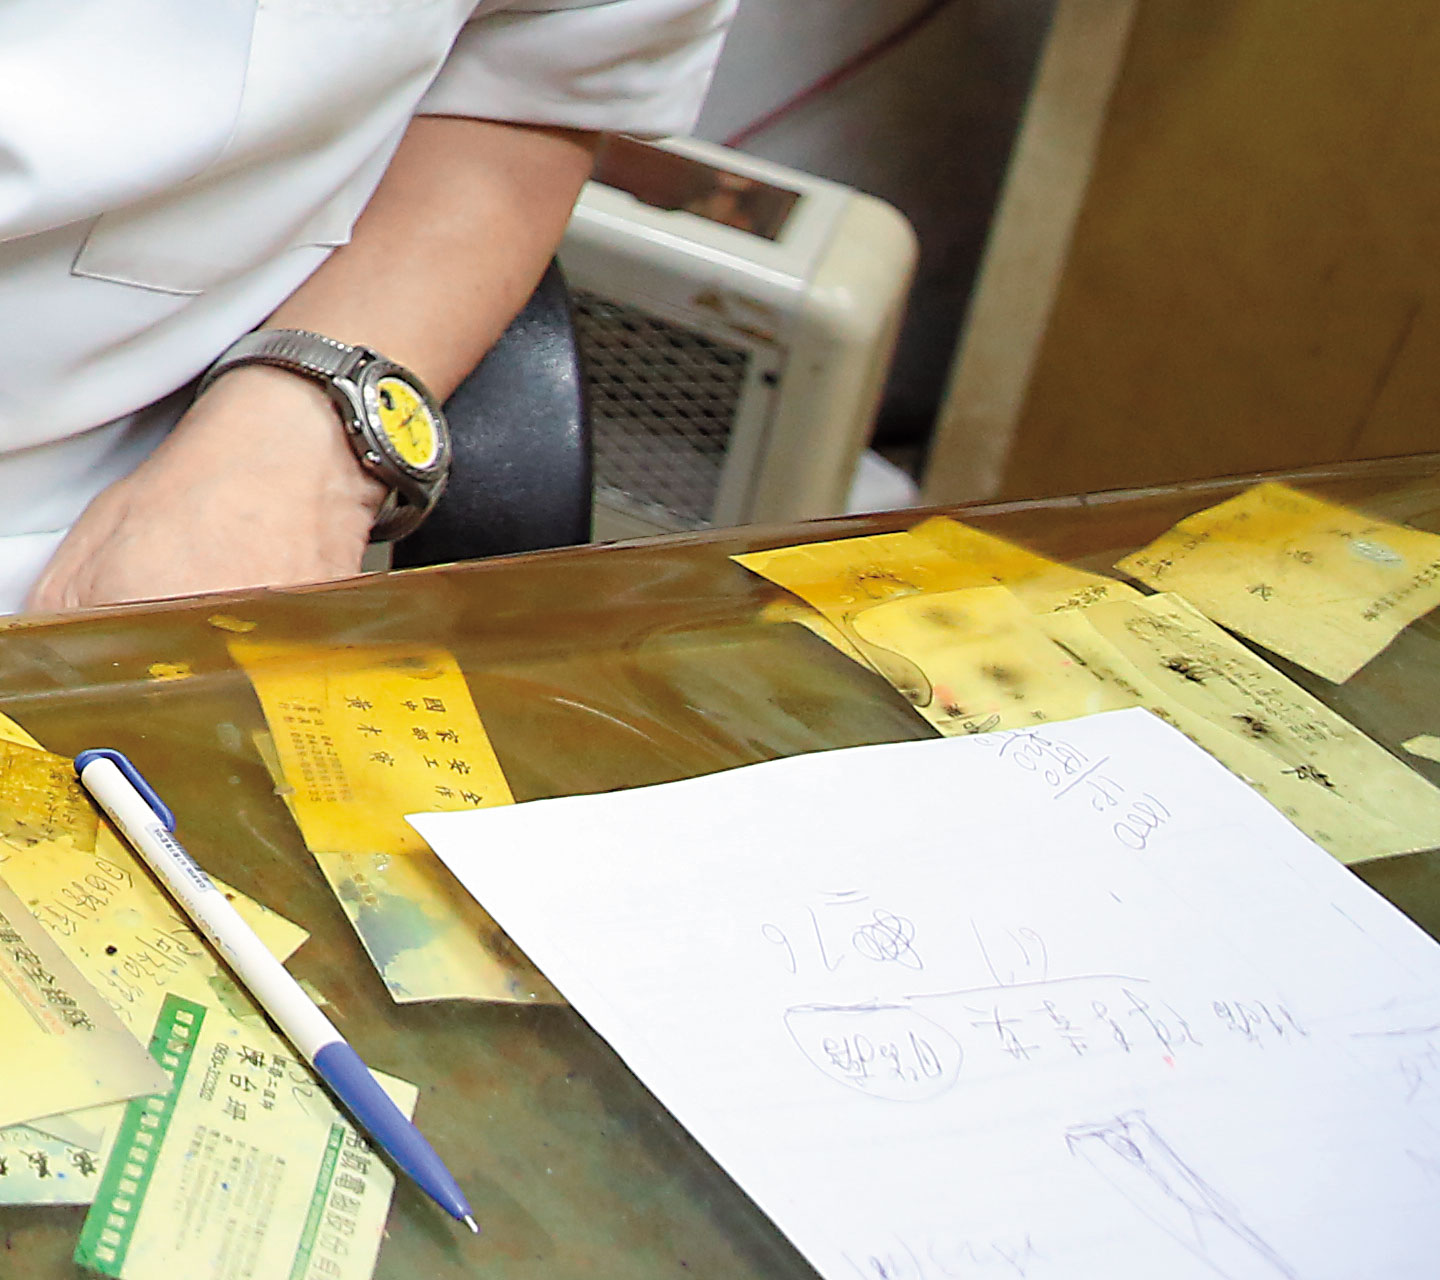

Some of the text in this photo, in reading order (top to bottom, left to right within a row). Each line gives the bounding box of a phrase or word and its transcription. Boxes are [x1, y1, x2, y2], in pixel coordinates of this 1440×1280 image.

[400, 699, 454, 810] 中部工作
[423, 696, 483, 806] 國家安全
